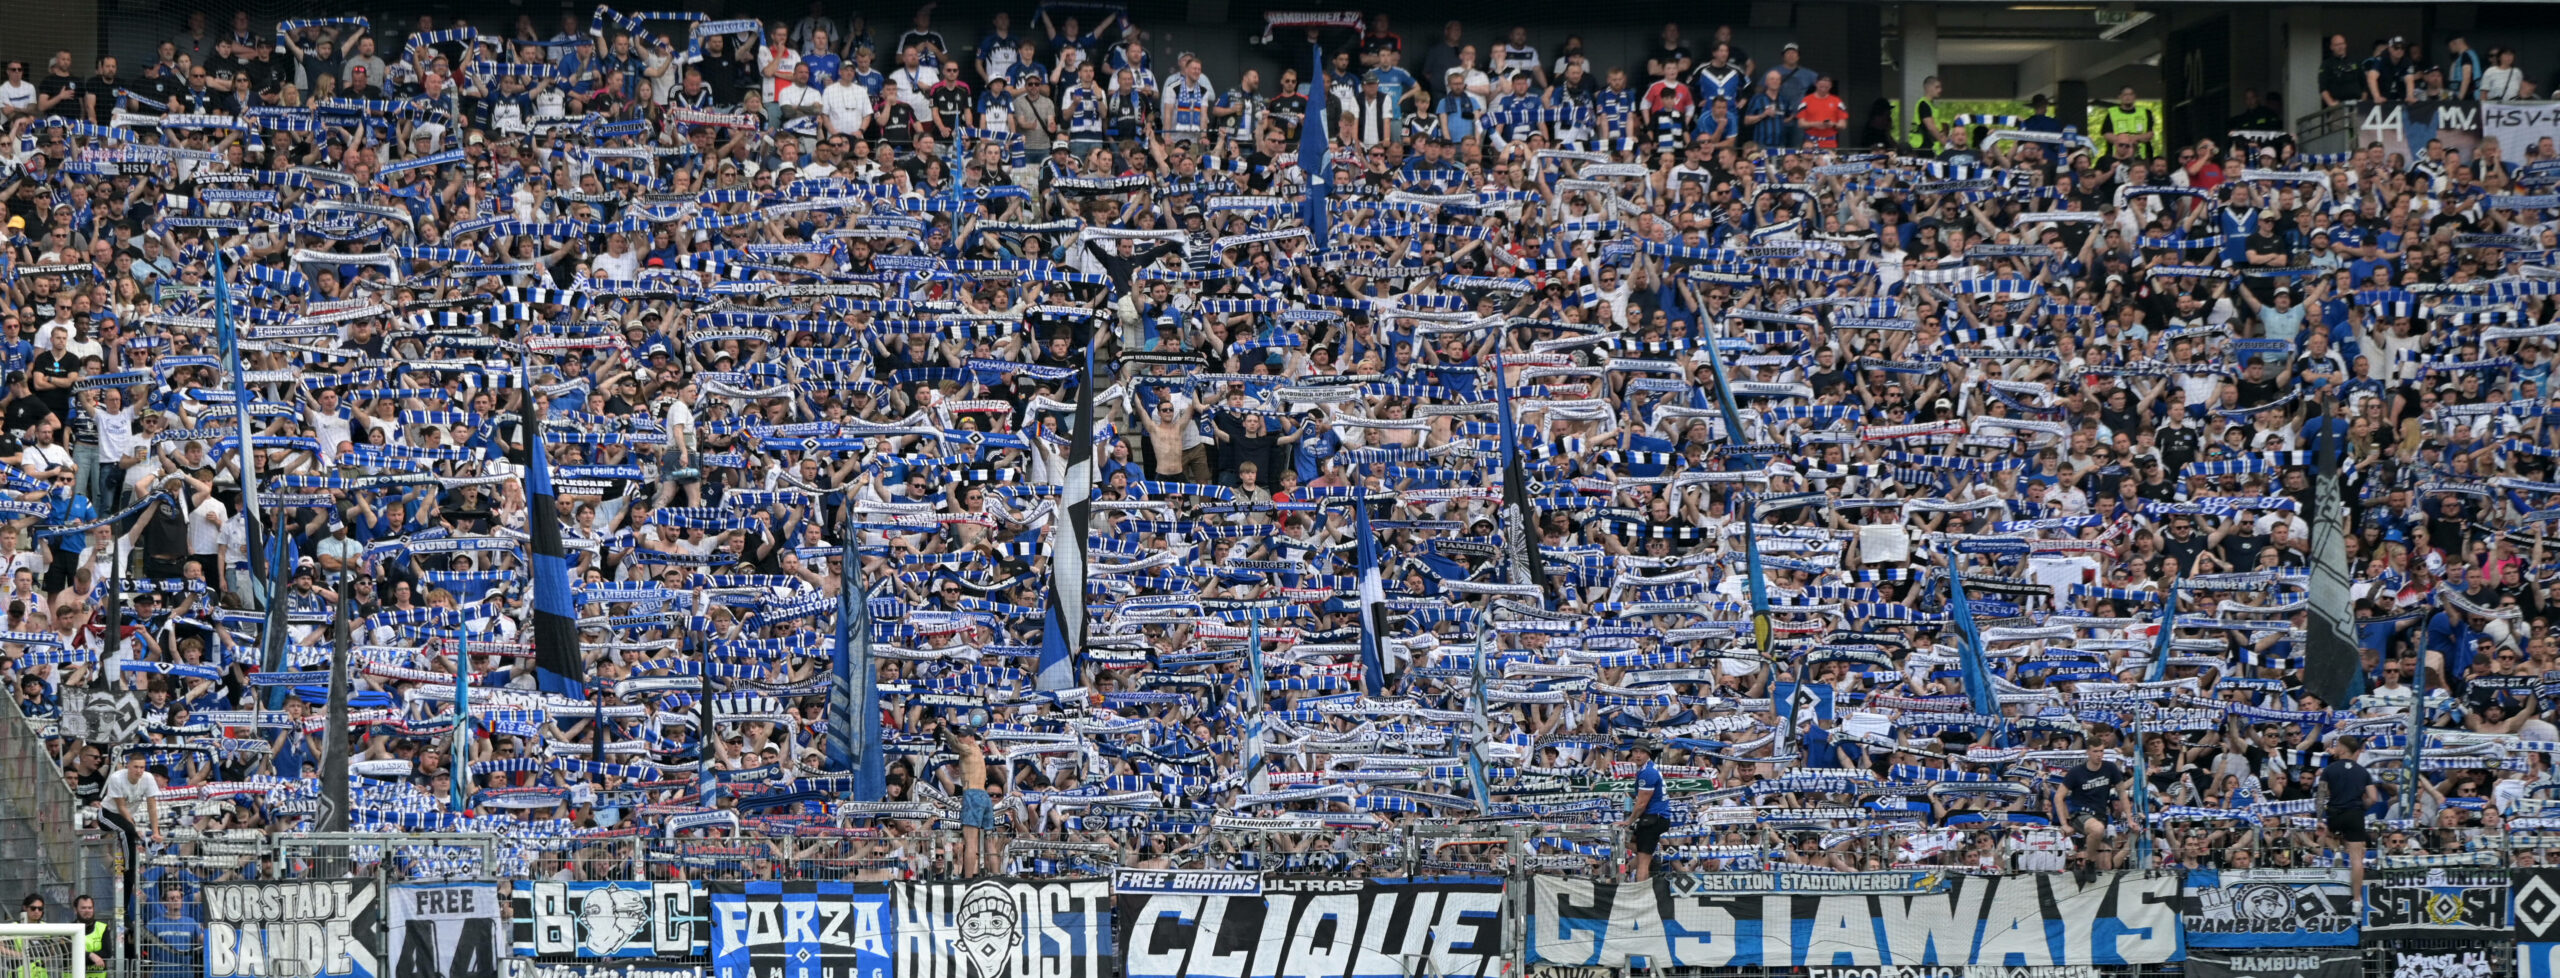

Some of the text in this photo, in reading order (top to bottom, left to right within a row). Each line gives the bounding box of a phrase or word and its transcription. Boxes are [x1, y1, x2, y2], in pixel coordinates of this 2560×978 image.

[164, 115, 232, 127] EKTION
[2360, 105, 2403, 142] 44
[65, 162, 92, 172] NUR
[123, 164, 149, 174] HSV
[557, 190, 618, 203] AMBURGER
[748, 243, 811, 252] HAMBURGER
[1747, 248, 1799, 257] MBURGER
[874, 257, 930, 268] HAMBURGER
[1352, 266, 1429, 278] HAMBURG
[2152, 266, 2212, 277] MBURGER
[211, 403, 279, 416] HAURG
[948, 400, 1011, 411] MBURGER
[1721, 445, 1785, 456] OLKSPAR
[616, 467, 641, 477] Crew
[551, 479, 612, 488] OLKSPARK
[559, 487, 604, 496] STADION
[2258, 497, 2286, 508] 87
[1437, 542, 1493, 553] HAMBUR
[1228, 560, 1294, 570] AMBURGER
[2178, 579, 2245, 590] AMBURGER
[587, 590, 663, 601] HAMBURGER
[612, 616, 661, 627] BURGER
[1497, 620, 1571, 631] EKTION
[1582, 628, 1647, 641] AMBURGER
[444, 641, 531, 655] HMBURGER
[2472, 679, 2505, 688] HEISS
[2079, 689, 2164, 702] TESTE CALDE
[1327, 703, 1353, 713] ORD
[2130, 723, 2162, 734] TSTE
[2420, 757, 2481, 769] EKTION
[1269, 772, 1313, 784] URGER
[1752, 779, 1846, 791] CASTAWAYS
[604, 792, 647, 806] HSV
[1771, 809, 1865, 819] CASTAWAYS
[2252, 801, 2315, 815] EKTION
[1221, 819, 1294, 829] HAMBURGER
[1117, 872, 1166, 890] FREE
[1172, 873, 1259, 891] BRATANS
[1703, 873, 1911, 891] SEKTION STADIONVERBOT
[2384, 871, 2508, 888] BOYS UNITED
[204, 881, 352, 922] VORSTADT
[415, 889, 475, 915] FREE
[1534, 873, 2178, 967] CASTAWAYS
[2187, 912, 2352, 935] HAMBURG SÜD
[714, 901, 890, 958] FORZA
[1127, 892, 1504, 978] CLIQUE
[208, 920, 351, 978] BANDE
[2230, 955, 2321, 973] HAMBURG
